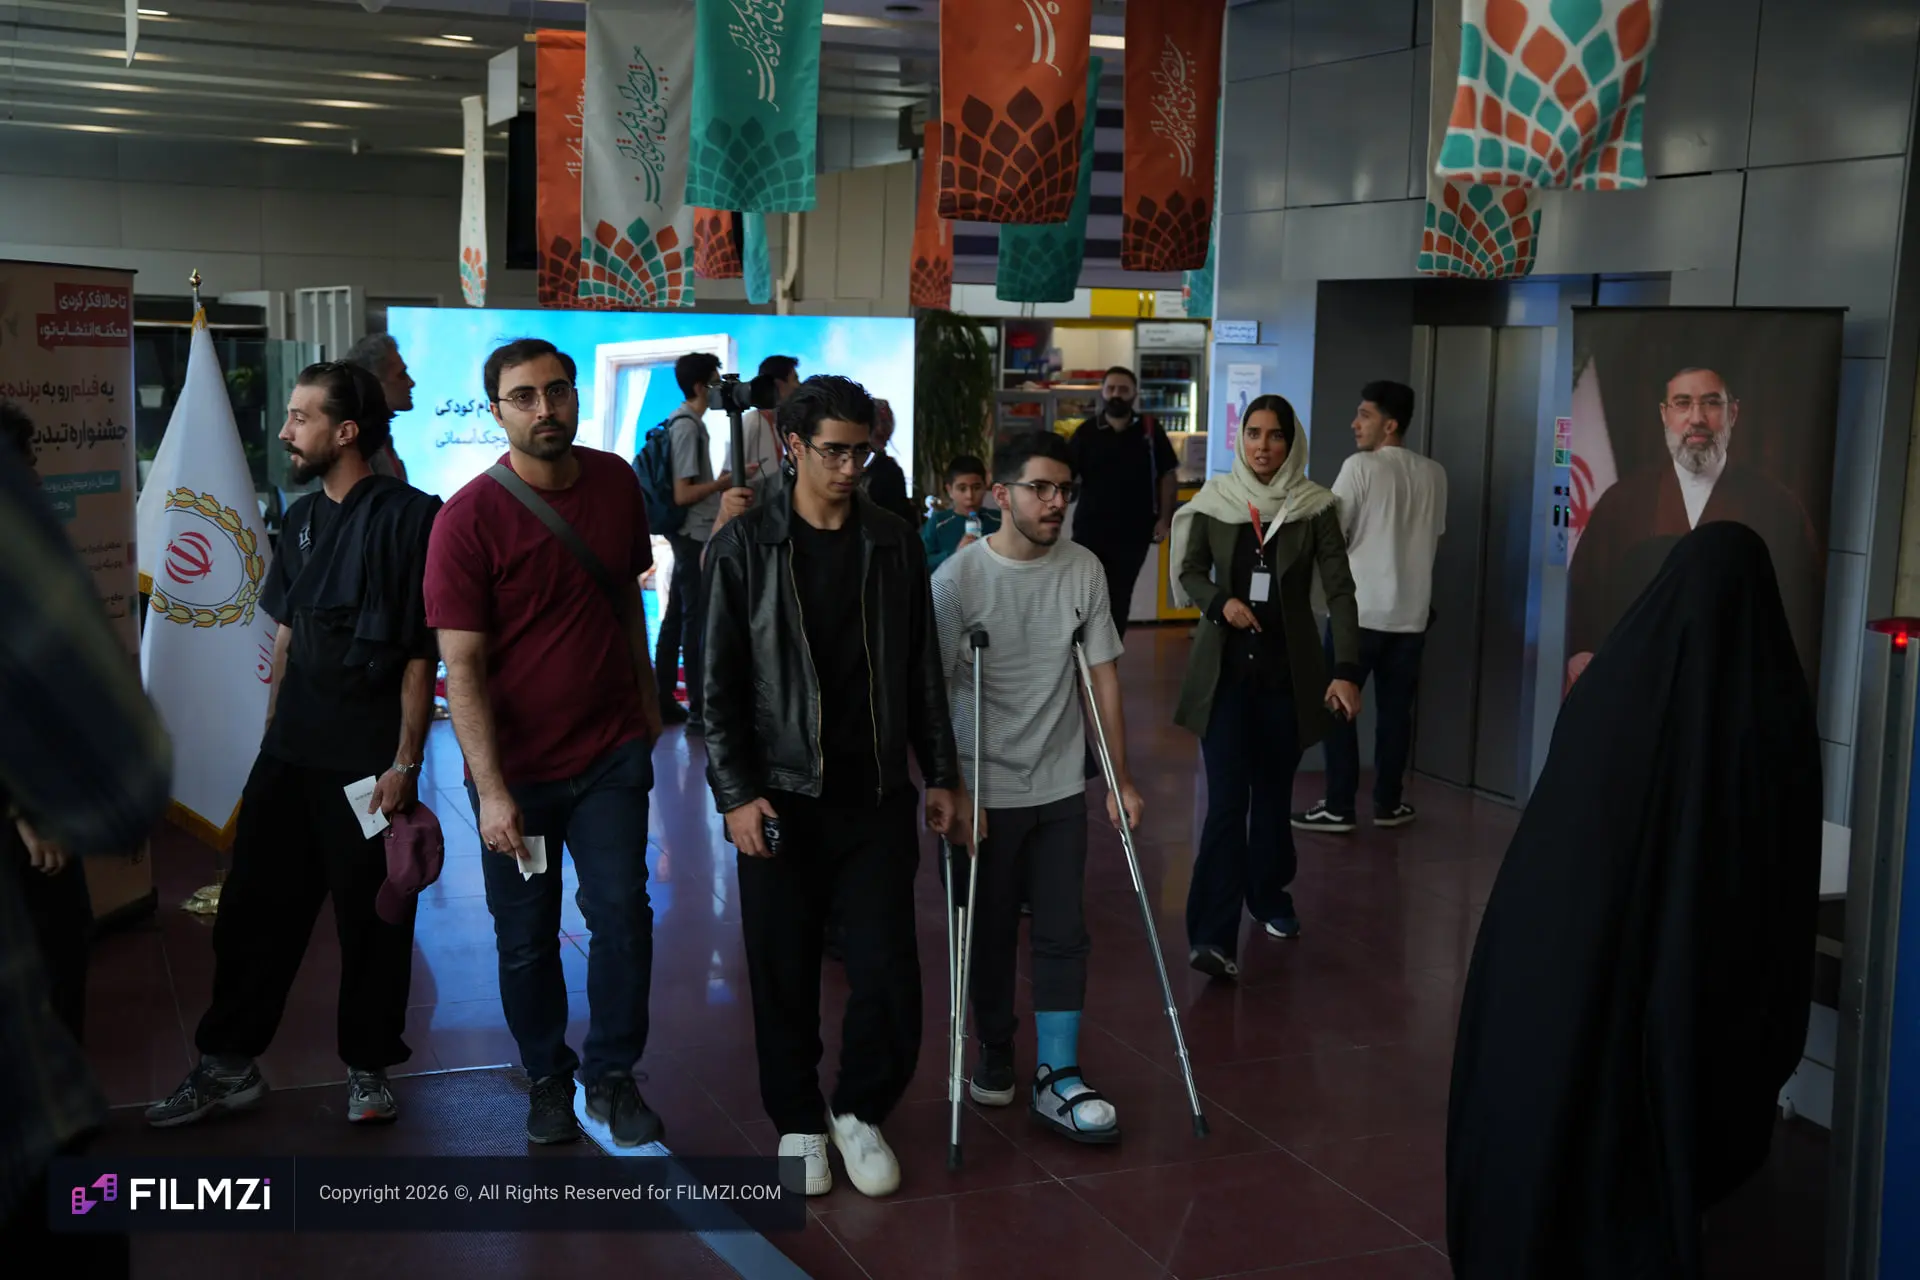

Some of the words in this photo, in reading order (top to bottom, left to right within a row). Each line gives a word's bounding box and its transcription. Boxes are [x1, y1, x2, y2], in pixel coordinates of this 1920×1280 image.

[59, 290, 84, 312] کردی
[83, 289, 102, 312] فکر
[95, 320, 128, 338] ممکنه
[42, 380, 56, 405] به
[71, 374, 99, 403] فیلم
[100, 381, 114, 403] یه
[435, 398, 475, 417] کودکی
[31, 422, 68, 452] تبدی
[70, 417, 128, 450] جشنواره
[477, 429, 508, 450] وچک
